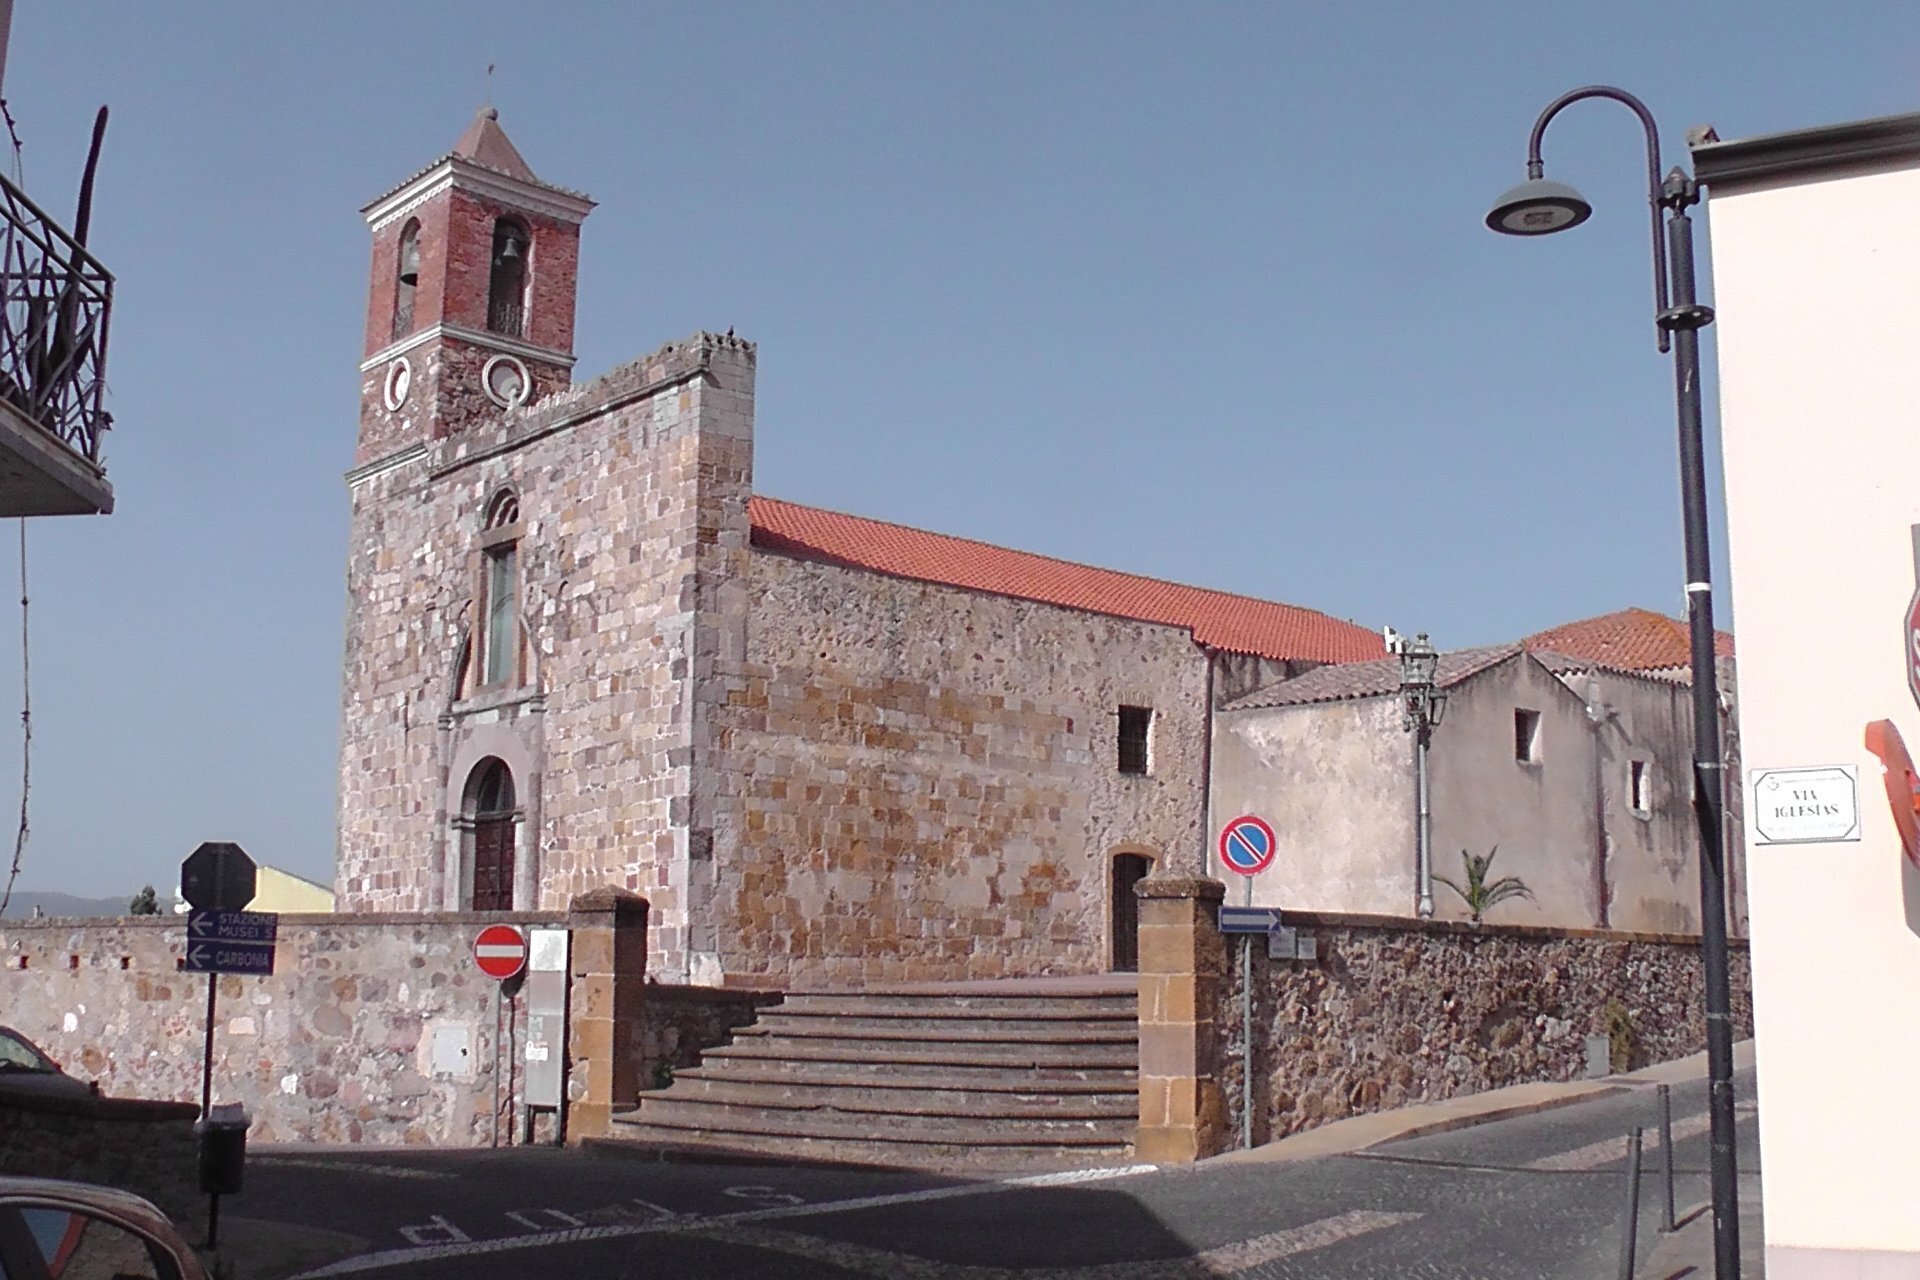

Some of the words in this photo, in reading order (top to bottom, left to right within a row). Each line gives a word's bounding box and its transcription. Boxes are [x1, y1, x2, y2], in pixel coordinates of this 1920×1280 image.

[1793, 789, 1818, 801] VIA
[1774, 803, 1840, 818] IGLESIAS
[218, 912, 277, 926] STAZIONE
[217, 926, 259, 938] MUSEI
[215, 951, 269, 966] CARBONIA
